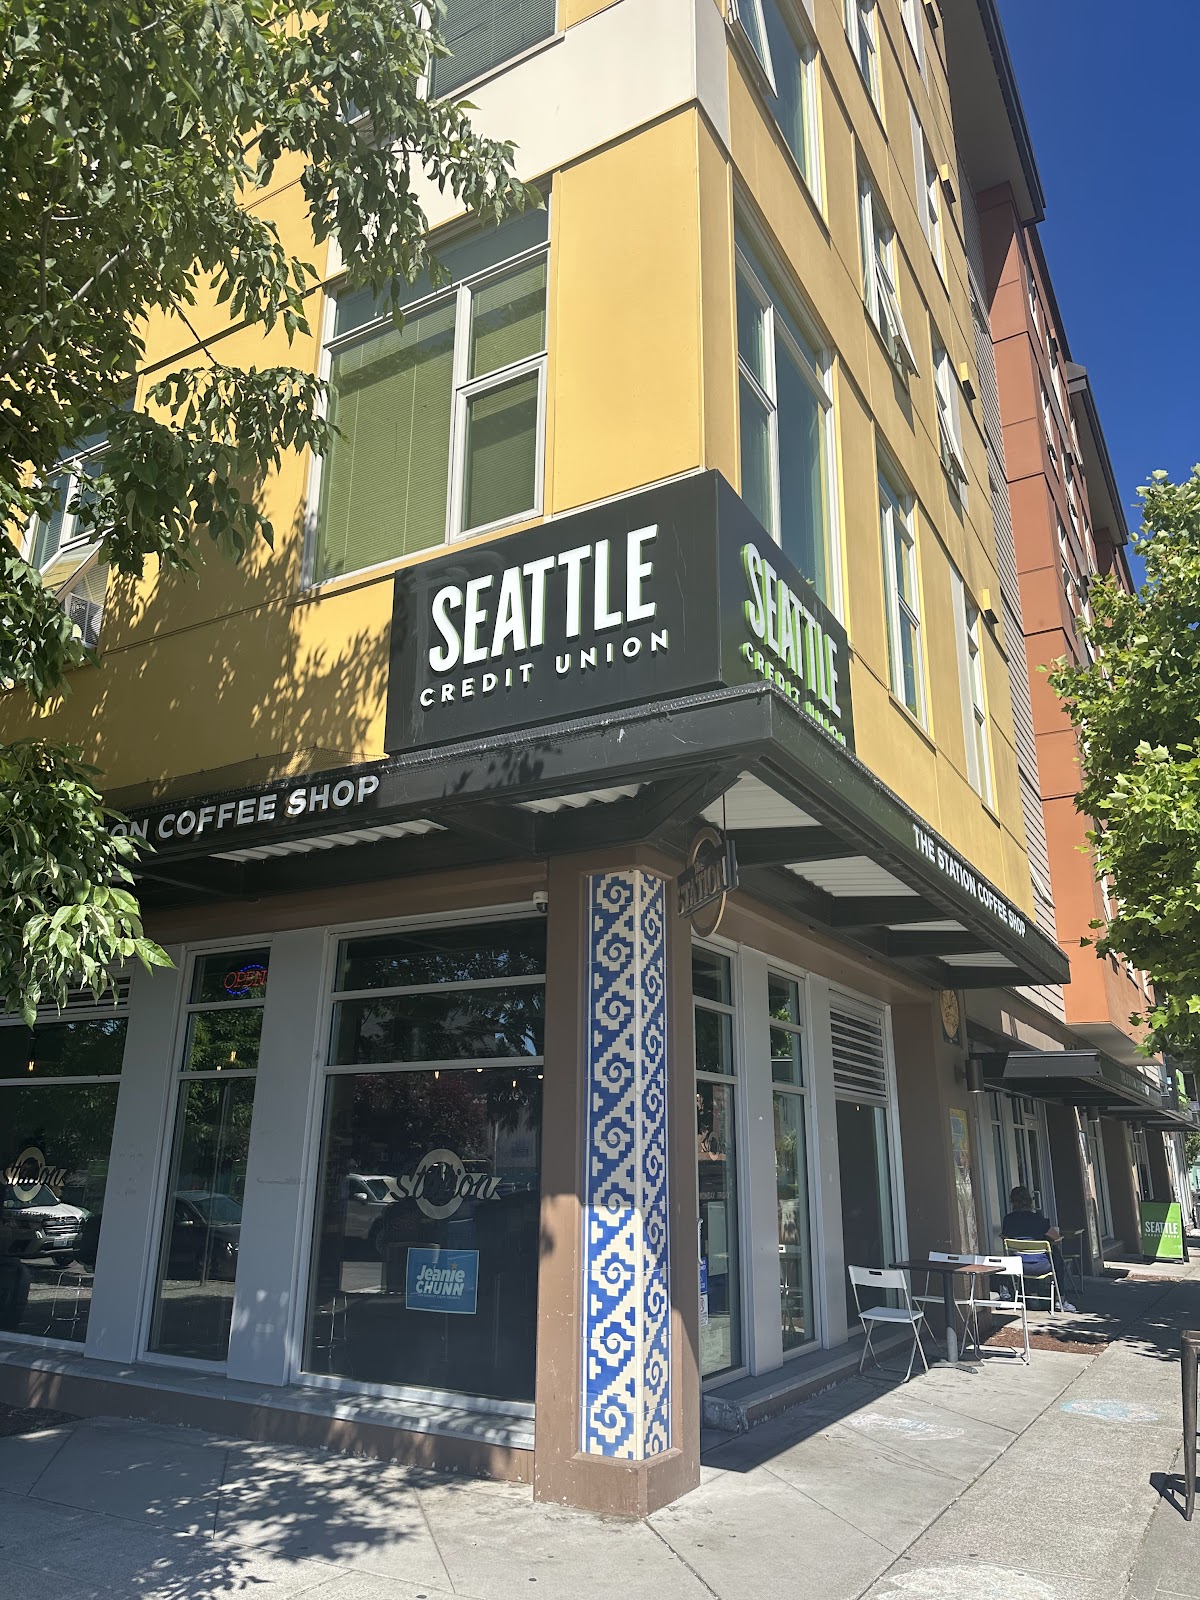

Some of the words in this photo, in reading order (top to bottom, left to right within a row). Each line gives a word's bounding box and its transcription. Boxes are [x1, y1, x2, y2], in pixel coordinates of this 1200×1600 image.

[428, 523, 659, 673] SEATTLE
[740, 542, 842, 719] SEATTLE
[419, 662, 535, 708] CREDIT
[555, 628, 669, 674] UNION
[740, 642, 800, 704] CREDIT
[157, 793, 277, 839] COFFEE
[286, 775, 380, 816] SHOP
[912, 823, 936, 863] THE
[937, 846, 977, 898] STATION
[977, 882, 1008, 924] COFFEE
[1008, 909, 1026, 938] SHOP
[224, 970, 267, 989] OPEN
[1145, 1221, 1178, 1234] SEATTLE
[415, 1280, 464, 1296] CHUNN
[416, 1264, 465, 1282] Jeanie
